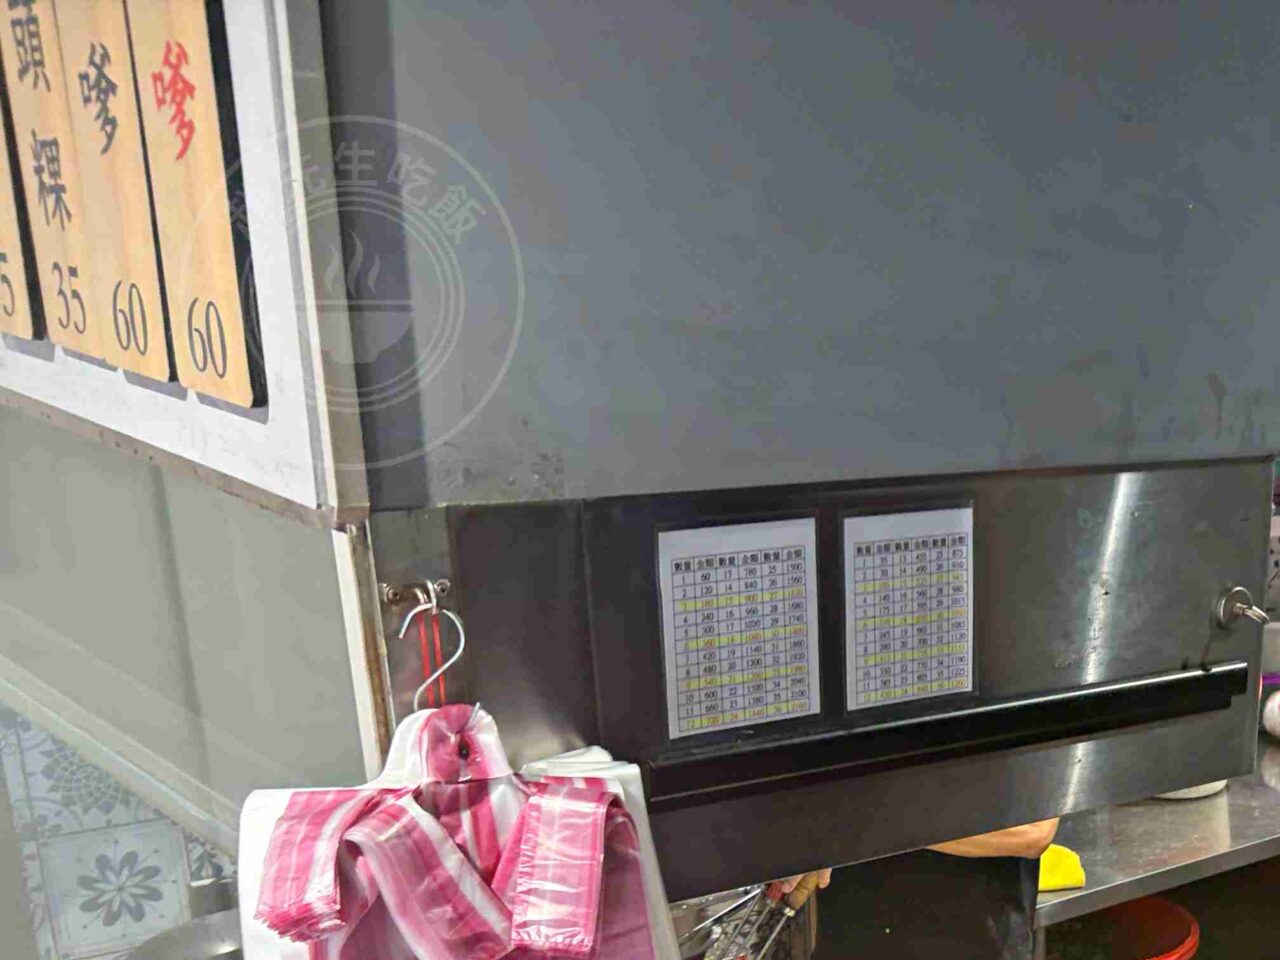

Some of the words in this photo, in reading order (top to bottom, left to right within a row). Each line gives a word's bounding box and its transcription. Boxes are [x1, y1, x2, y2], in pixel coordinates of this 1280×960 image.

[78, 41, 118, 156] 嗲
[152, 40, 196, 161] 嗲
[51, 261, 88, 335] 35
[112, 280, 149, 357] 60
[187, 296, 229, 379] 60
[701, 572, 710, 581] 60
[724, 570, 732, 579] 13
[744, 567, 756, 576] 780
[768, 565, 776, 573] 25
[786, 561, 802, 571] 1500
[699, 585, 713, 595] 120
[724, 583, 732, 592] 14
[744, 580, 757, 589] 840
[768, 578, 776, 586] 26
[787, 574, 803, 584] 1560
[701, 612, 714, 621] 240
[725, 609, 734, 618] 16
[745, 606, 758, 615] 960
[769, 603, 777, 612] 28
[788, 600, 803, 610] 1680
[701, 625, 714, 634] 300
[726, 622, 734, 631] 17
[745, 619, 761, 629] 1020
[770, 616, 778, 625] 29
[788, 613, 804, 623] 1740
[702, 651, 715, 661] 420
[727, 648, 735, 657] 19
[746, 644, 762, 654] 1140
[770, 642, 778, 651] 31
[789, 638, 805, 648] 1860
[703, 664, 716, 674] 480
[727, 661, 736, 670] 20
[746, 657, 762, 667] 1200
[771, 655, 779, 664] 32
[789, 651, 805, 661] 1920
[684, 693, 693, 703] 10
[704, 690, 717, 699] 600
[728, 687, 737, 696] 22
[747, 683, 763, 693] 1320
[772, 680, 780, 689] 34
[790, 676, 806, 686] 2040
[685, 706, 693, 715] 11
[705, 702, 718, 712] 660
[729, 699, 737, 708] 23
[748, 695, 764, 706] 1380
[772, 693, 780, 702] 35
[791, 689, 806, 699] 2100
